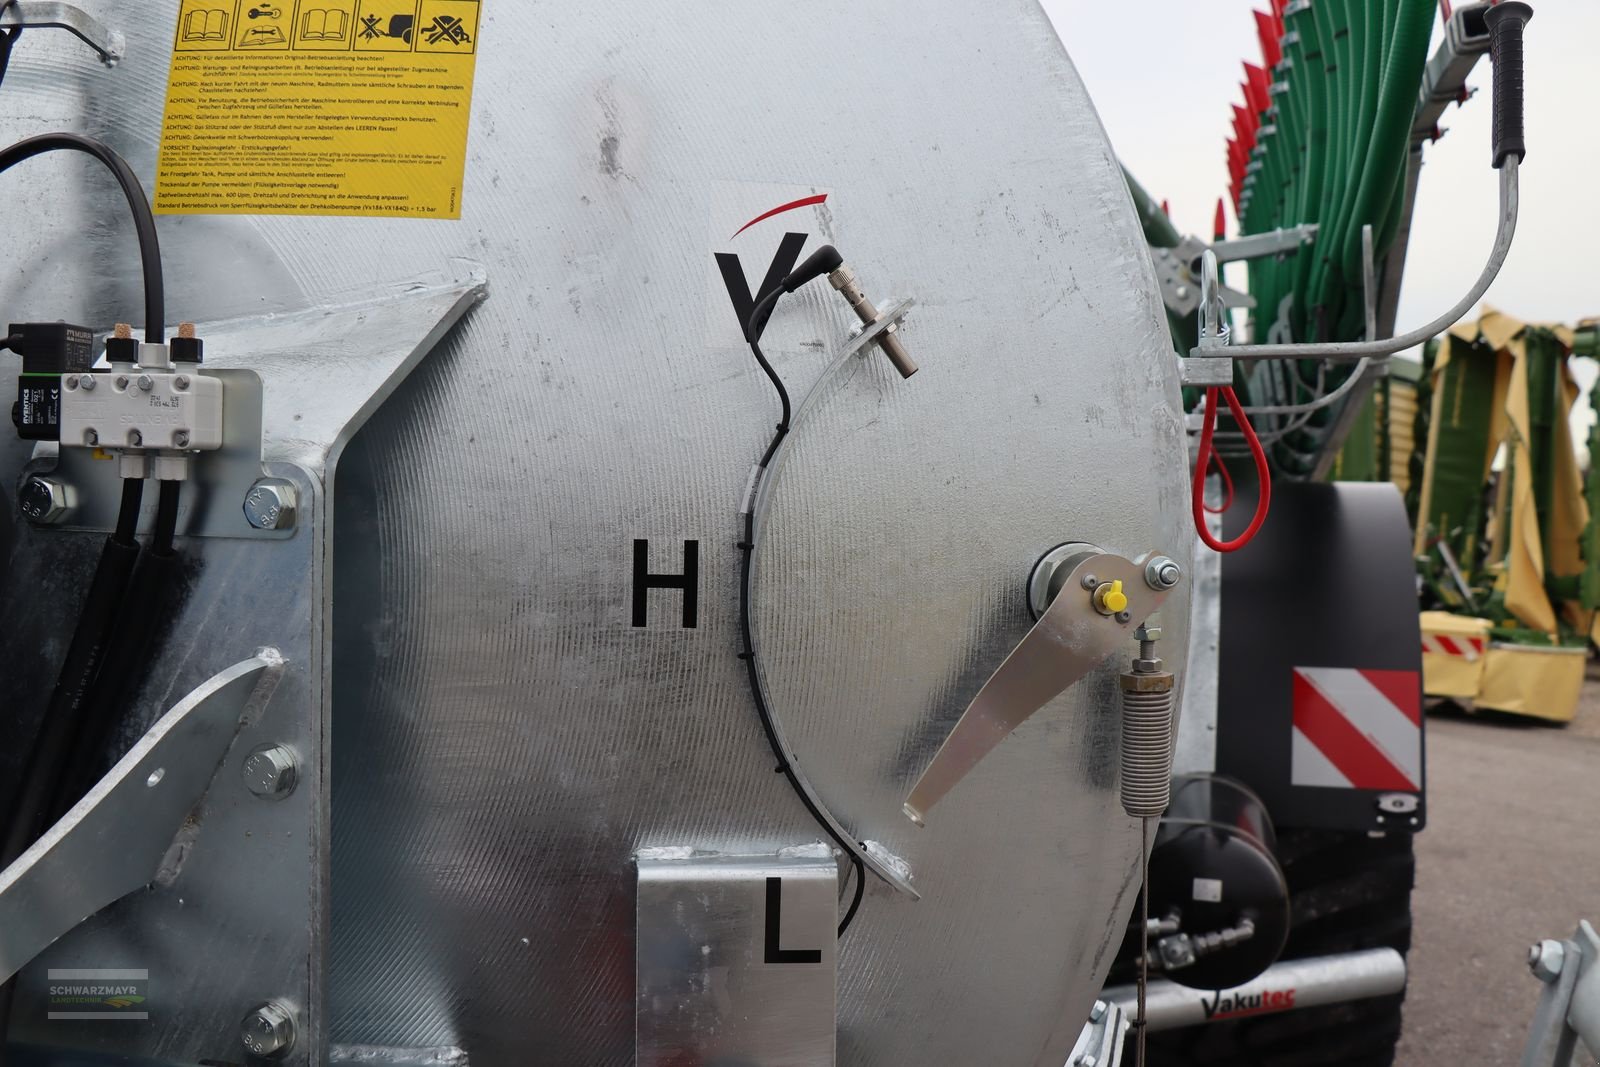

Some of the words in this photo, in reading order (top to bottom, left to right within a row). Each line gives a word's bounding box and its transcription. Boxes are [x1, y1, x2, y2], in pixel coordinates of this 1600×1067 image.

[632, 539, 698, 628] H
[764, 877, 821, 964] L
[1202, 988, 1296, 1018] Vakutec
